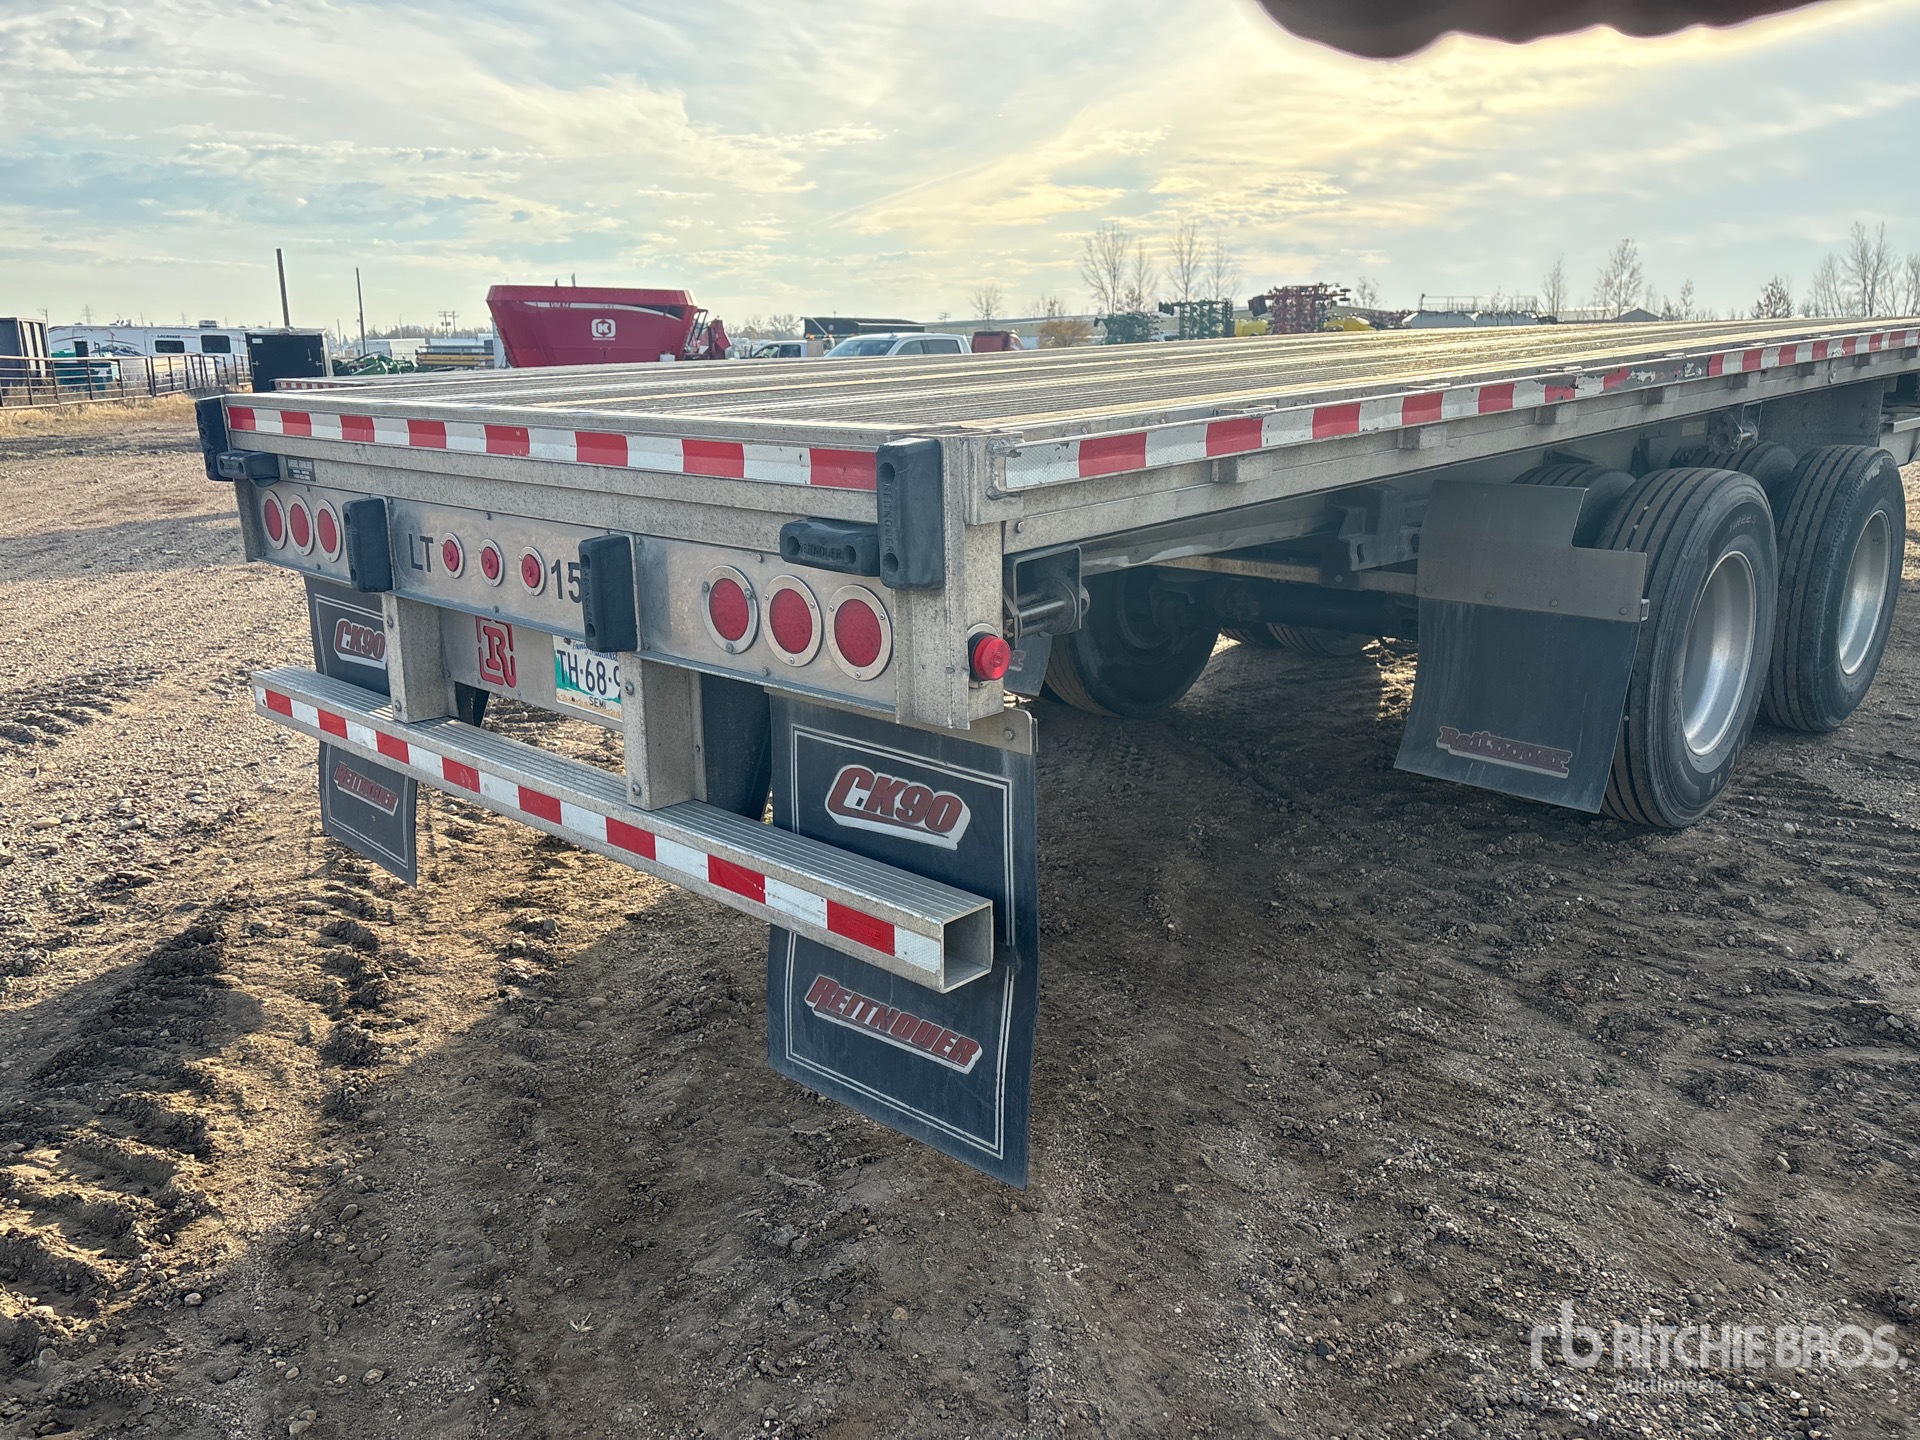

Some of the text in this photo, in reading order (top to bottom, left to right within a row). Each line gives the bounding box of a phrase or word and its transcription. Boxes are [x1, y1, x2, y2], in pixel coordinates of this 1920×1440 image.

[407, 533, 434, 573] LT
[550, 558, 582, 604] 15
[826, 766, 966, 843] CK90
[805, 975, 983, 1071] REITNOUER
